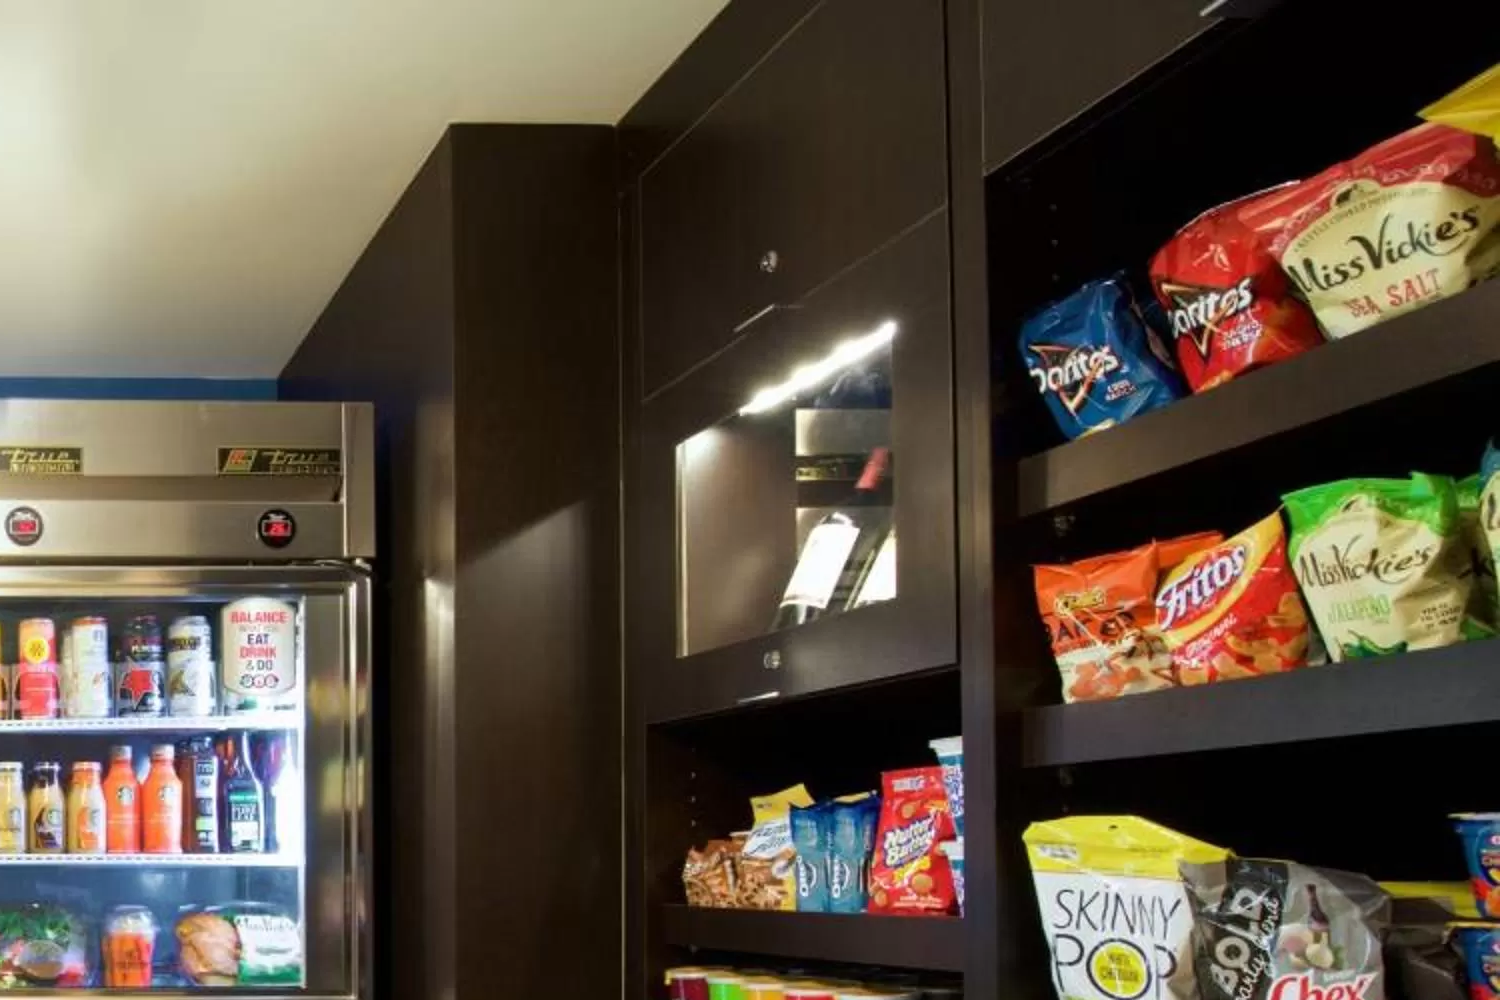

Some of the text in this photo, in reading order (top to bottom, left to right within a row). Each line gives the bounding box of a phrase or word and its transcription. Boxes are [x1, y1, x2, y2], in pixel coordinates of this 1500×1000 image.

[1287, 211, 1480, 294] Miss Vickie's
[1168, 277, 1254, 339] oritos
[1345, 267, 1443, 318] SEA SALT
[1299, 550, 1343, 588] Miss
[1155, 545, 1245, 632] Fritos
[229, 611, 288, 624] BALANCE
[239, 646, 277, 659] DRINK
[247, 633, 271, 645] EAT
[257, 660, 274, 671] DO
